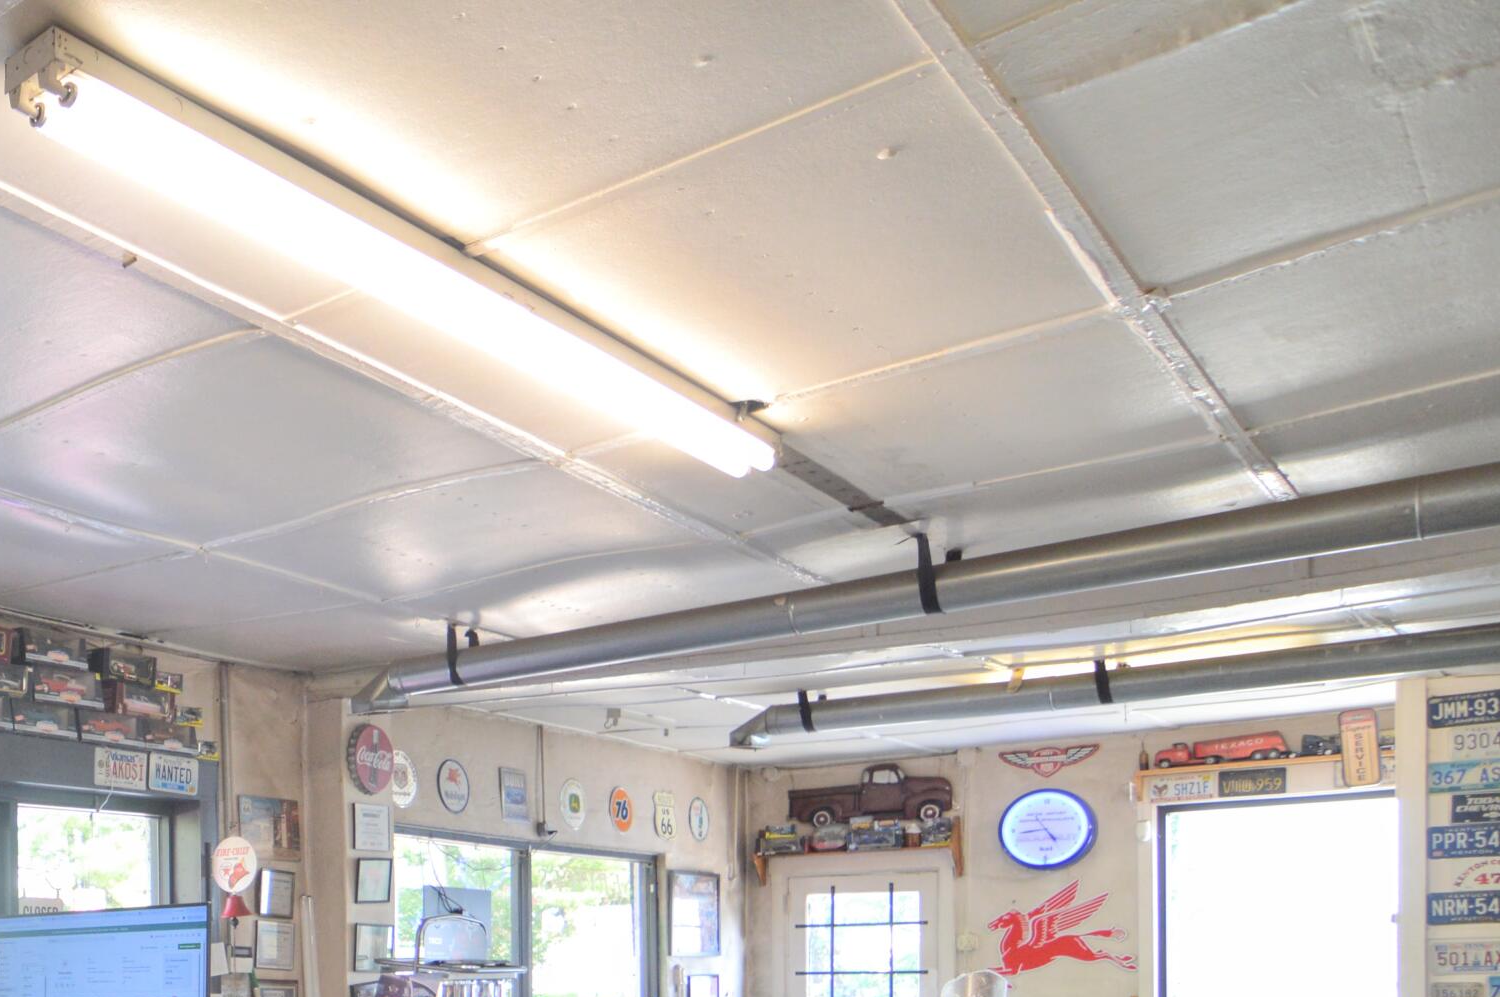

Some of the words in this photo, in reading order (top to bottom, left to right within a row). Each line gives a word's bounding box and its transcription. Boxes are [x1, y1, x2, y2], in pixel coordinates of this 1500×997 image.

[1214, 738, 1264, 751] TEXACO
[155, 762, 192, 785] WANTED
[1432, 768, 1467, 787] 367
[615, 799, 629, 821] 76
[660, 817, 673, 836] 66
